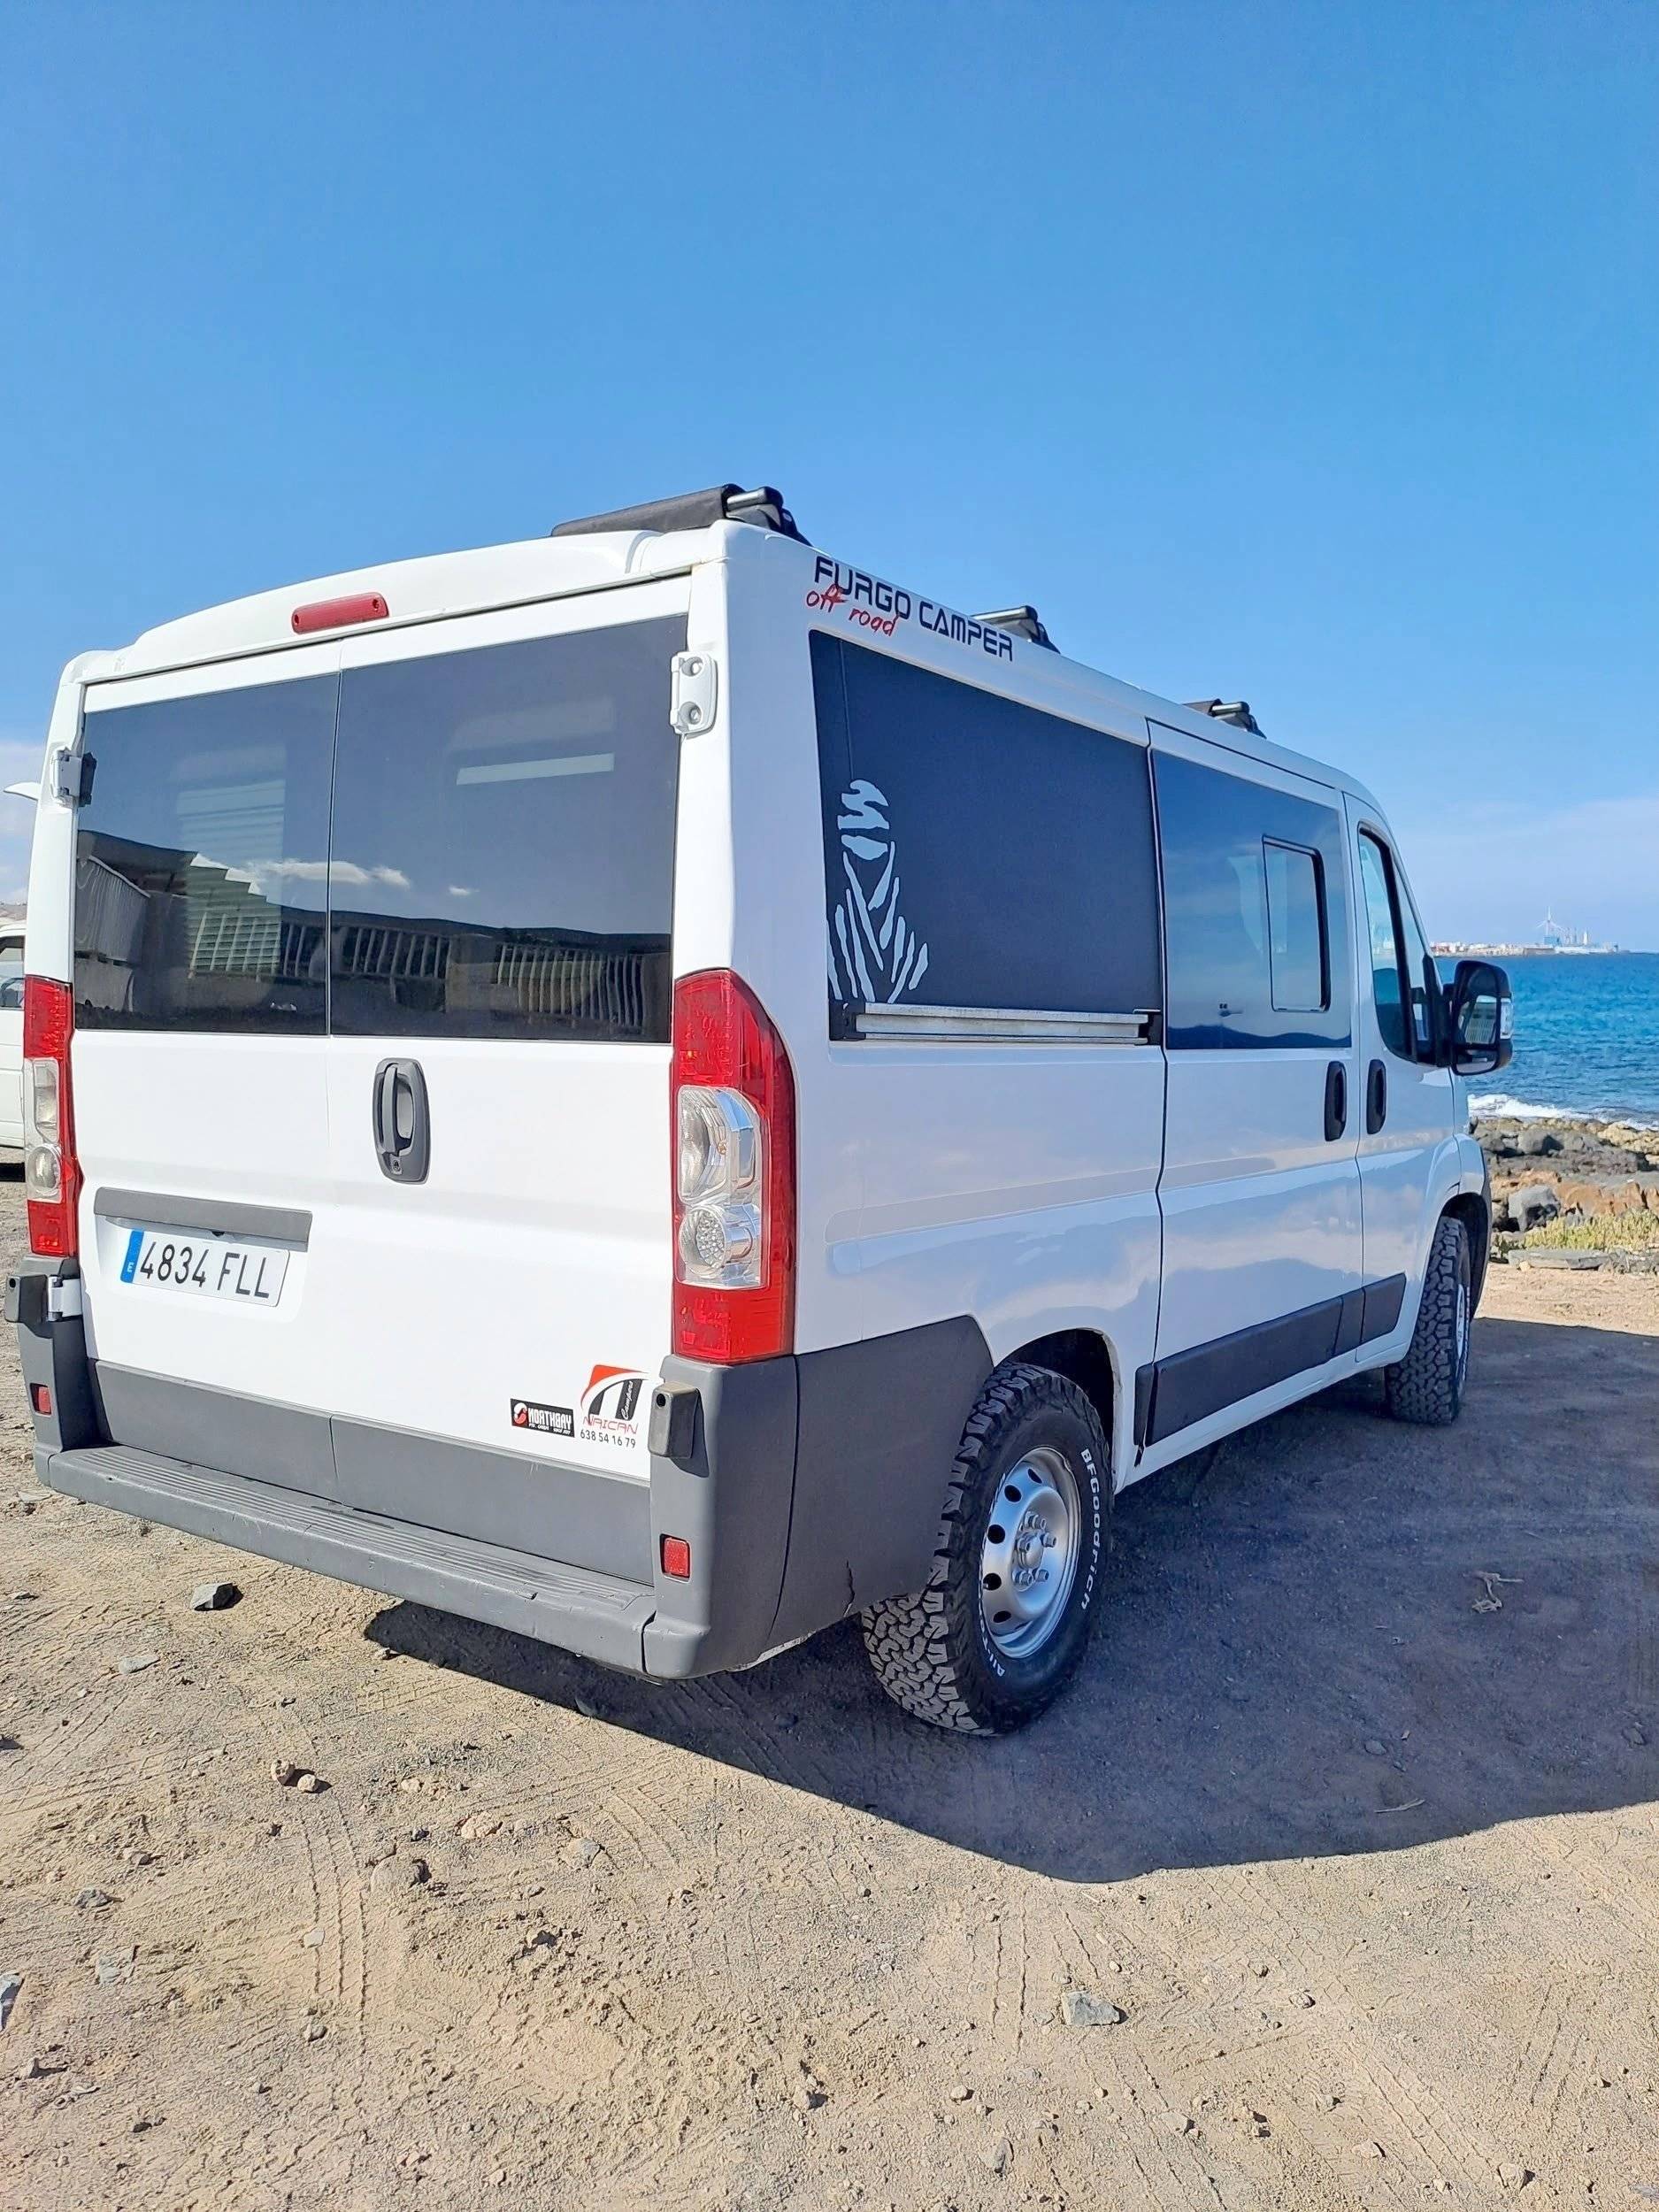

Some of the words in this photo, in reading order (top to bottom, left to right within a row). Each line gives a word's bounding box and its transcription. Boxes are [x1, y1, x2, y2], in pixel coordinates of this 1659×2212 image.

[806, 583, 849, 612] off
[849, 609, 900, 636] road
[814, 556, 911, 620] FURGO
[918, 601, 1013, 662] CAMPER
[140, 1240, 210, 1287] 4834
[217, 1251, 269, 1299] FLL
[580, 1429, 596, 1441] 638
[599, 1432, 610, 1443] 54
[612, 1435, 623, 1446] 16
[625, 1437, 636, 1448] 79
